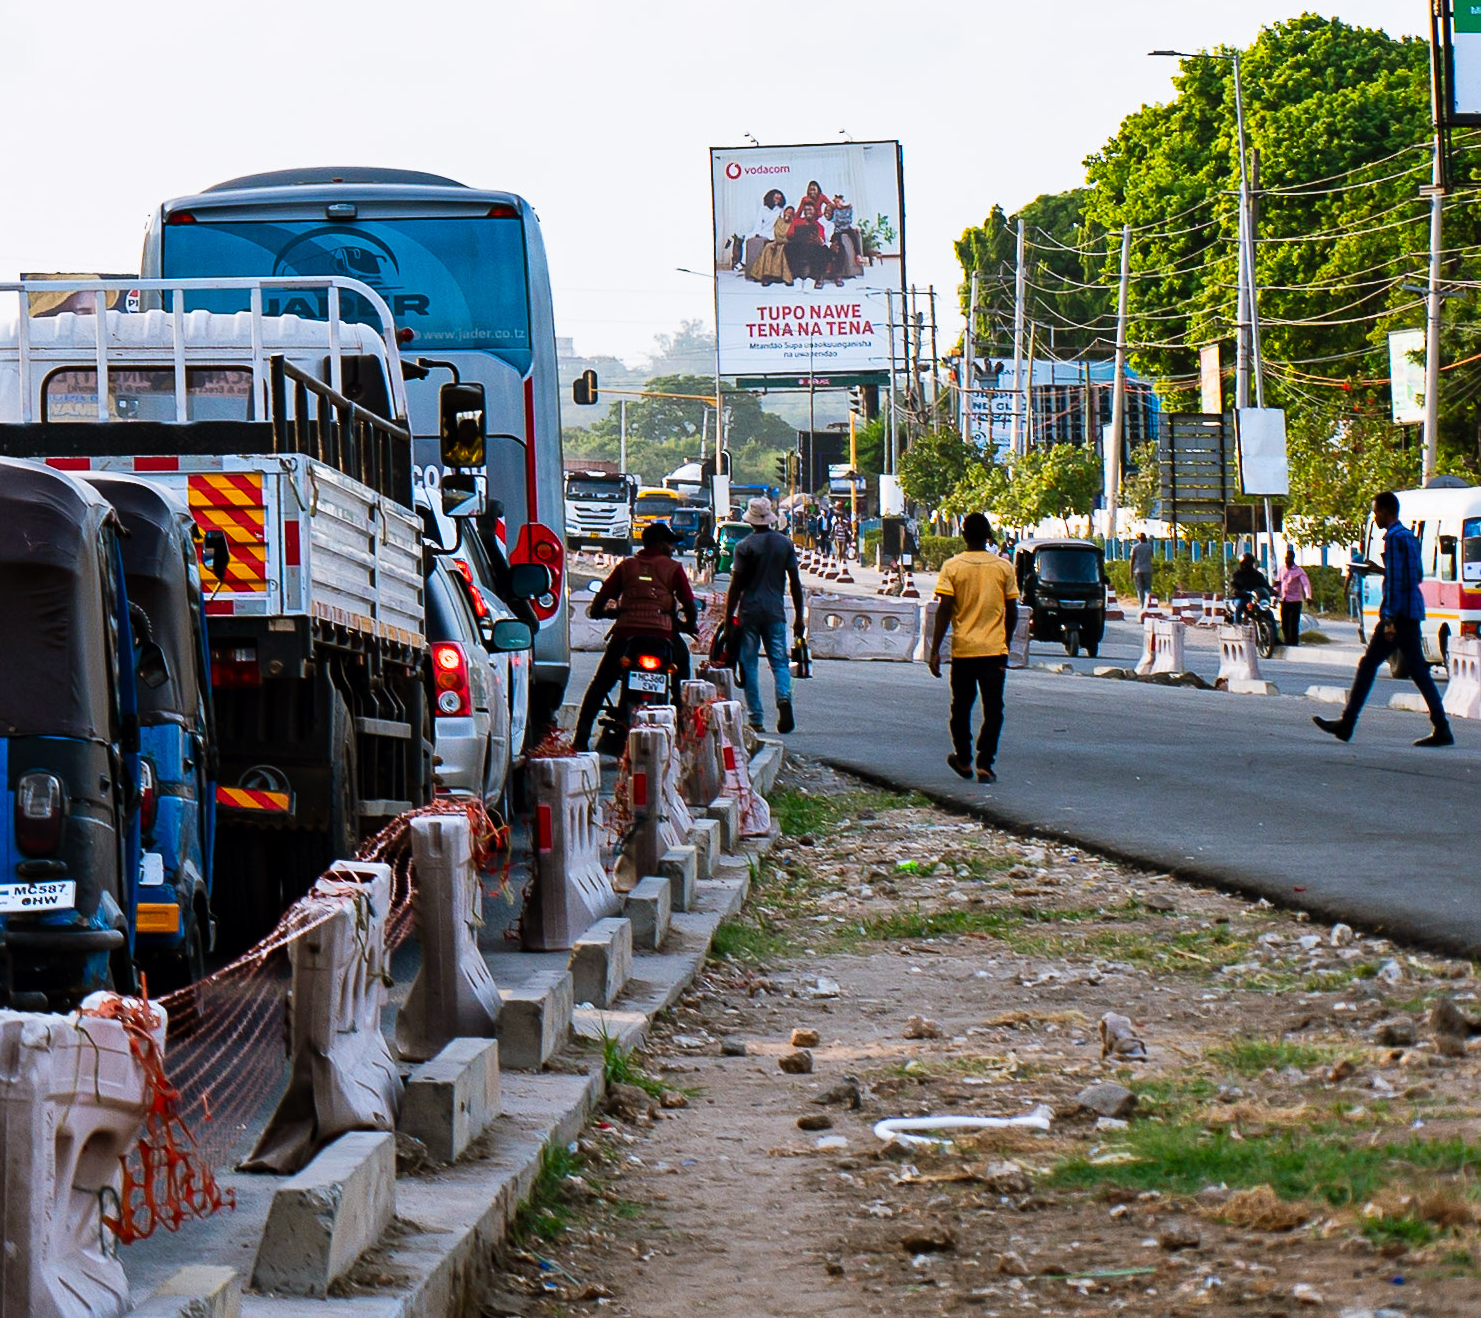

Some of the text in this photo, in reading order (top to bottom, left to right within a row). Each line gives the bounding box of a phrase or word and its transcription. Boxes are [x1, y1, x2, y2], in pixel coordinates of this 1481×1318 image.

[743, 164, 791, 175] vodacom
[756, 303, 862, 321] TUPO NAWE
[745, 319, 875, 338] TENA NA TENA
[13, 883, 67, 896] MC587
